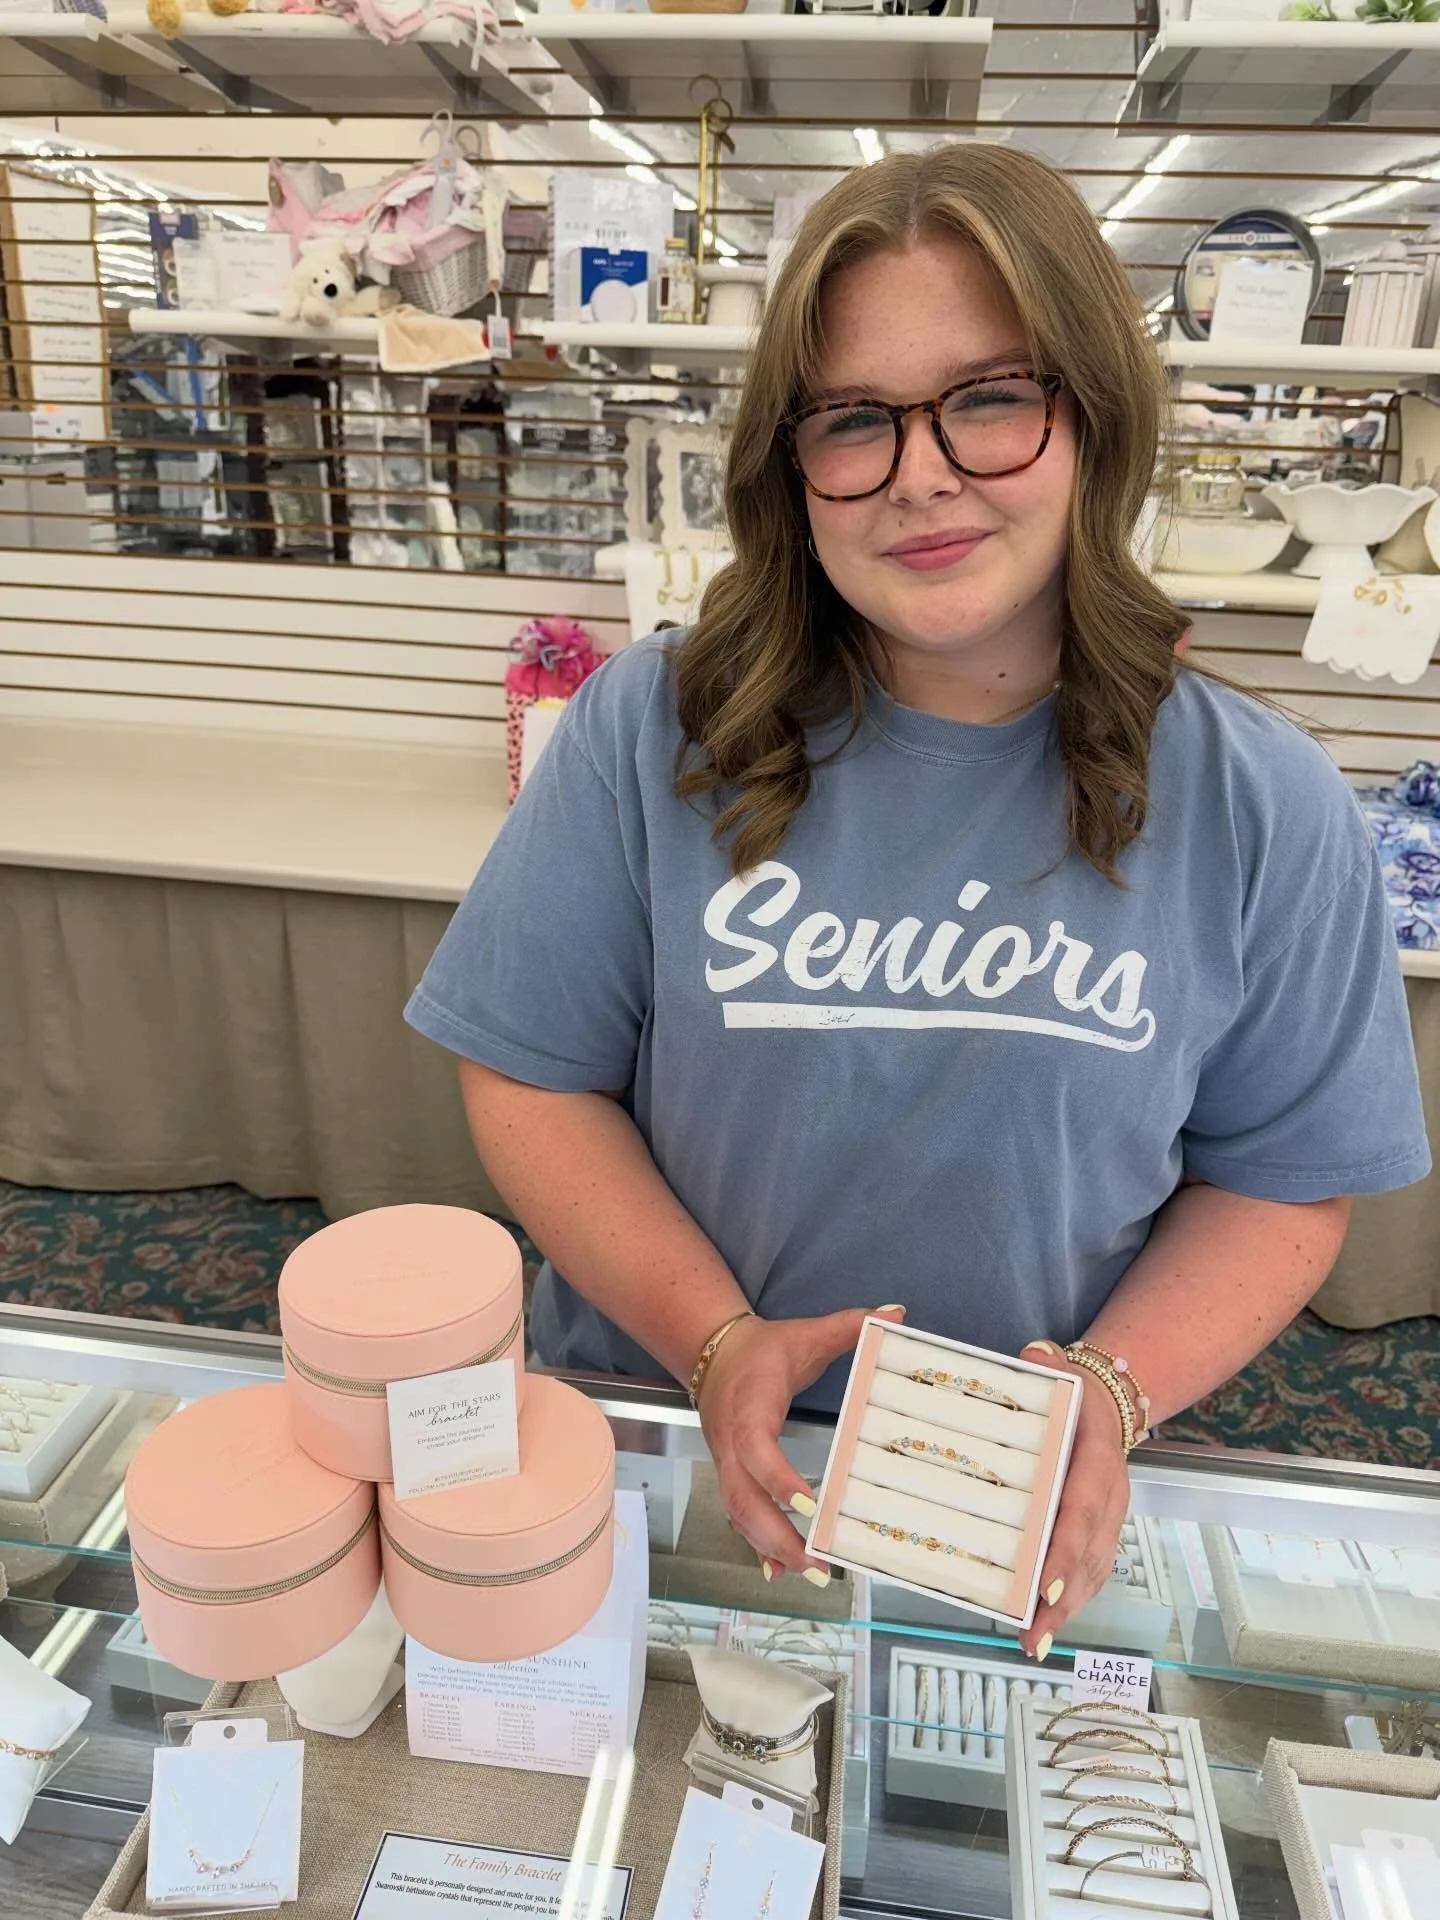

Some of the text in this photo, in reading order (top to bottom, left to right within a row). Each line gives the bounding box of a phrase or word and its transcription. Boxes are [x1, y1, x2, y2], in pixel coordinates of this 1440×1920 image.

[703, 861, 1156, 1030] Seniors
[407, 1393, 502, 1419] AIM FOR THE STARS
[425, 1405, 482, 1427] bracelet
[494, 1661, 539, 1674] collection
[1093, 1658, 1136, 1673] LAST
[1077, 1669, 1149, 1687] CHANCE
[1086, 1684, 1135, 1702] styles
[419, 1691, 613, 1720] BRACELET EARRINGS NECKLACE
[443, 1852, 563, 1882] The Family Bracelet
[168, 1882, 227, 1894] HANDCRAFTED
[375, 1880, 405, 1892] Swarovski
[405, 1884, 437, 1897] birthstone
[436, 1890, 460, 1902] crystals
[459, 1893, 473, 1903] that
[473, 1896, 502, 1908] represent
[502, 1900, 513, 1909] the
[513, 1902, 535, 1913] people
[535, 1905, 547, 1915] you
[390, 1872, 403, 1881] This
[403, 1874, 428, 1885] bracelet
[428, 1878, 435, 1886] is
[435, 1880, 466, 1891] personally
[466, 1884, 494, 1895] designed
[493, 1888, 506, 1897] and
[506, 1890, 524, 1900] made
[524, 1892, 535, 1902] for
